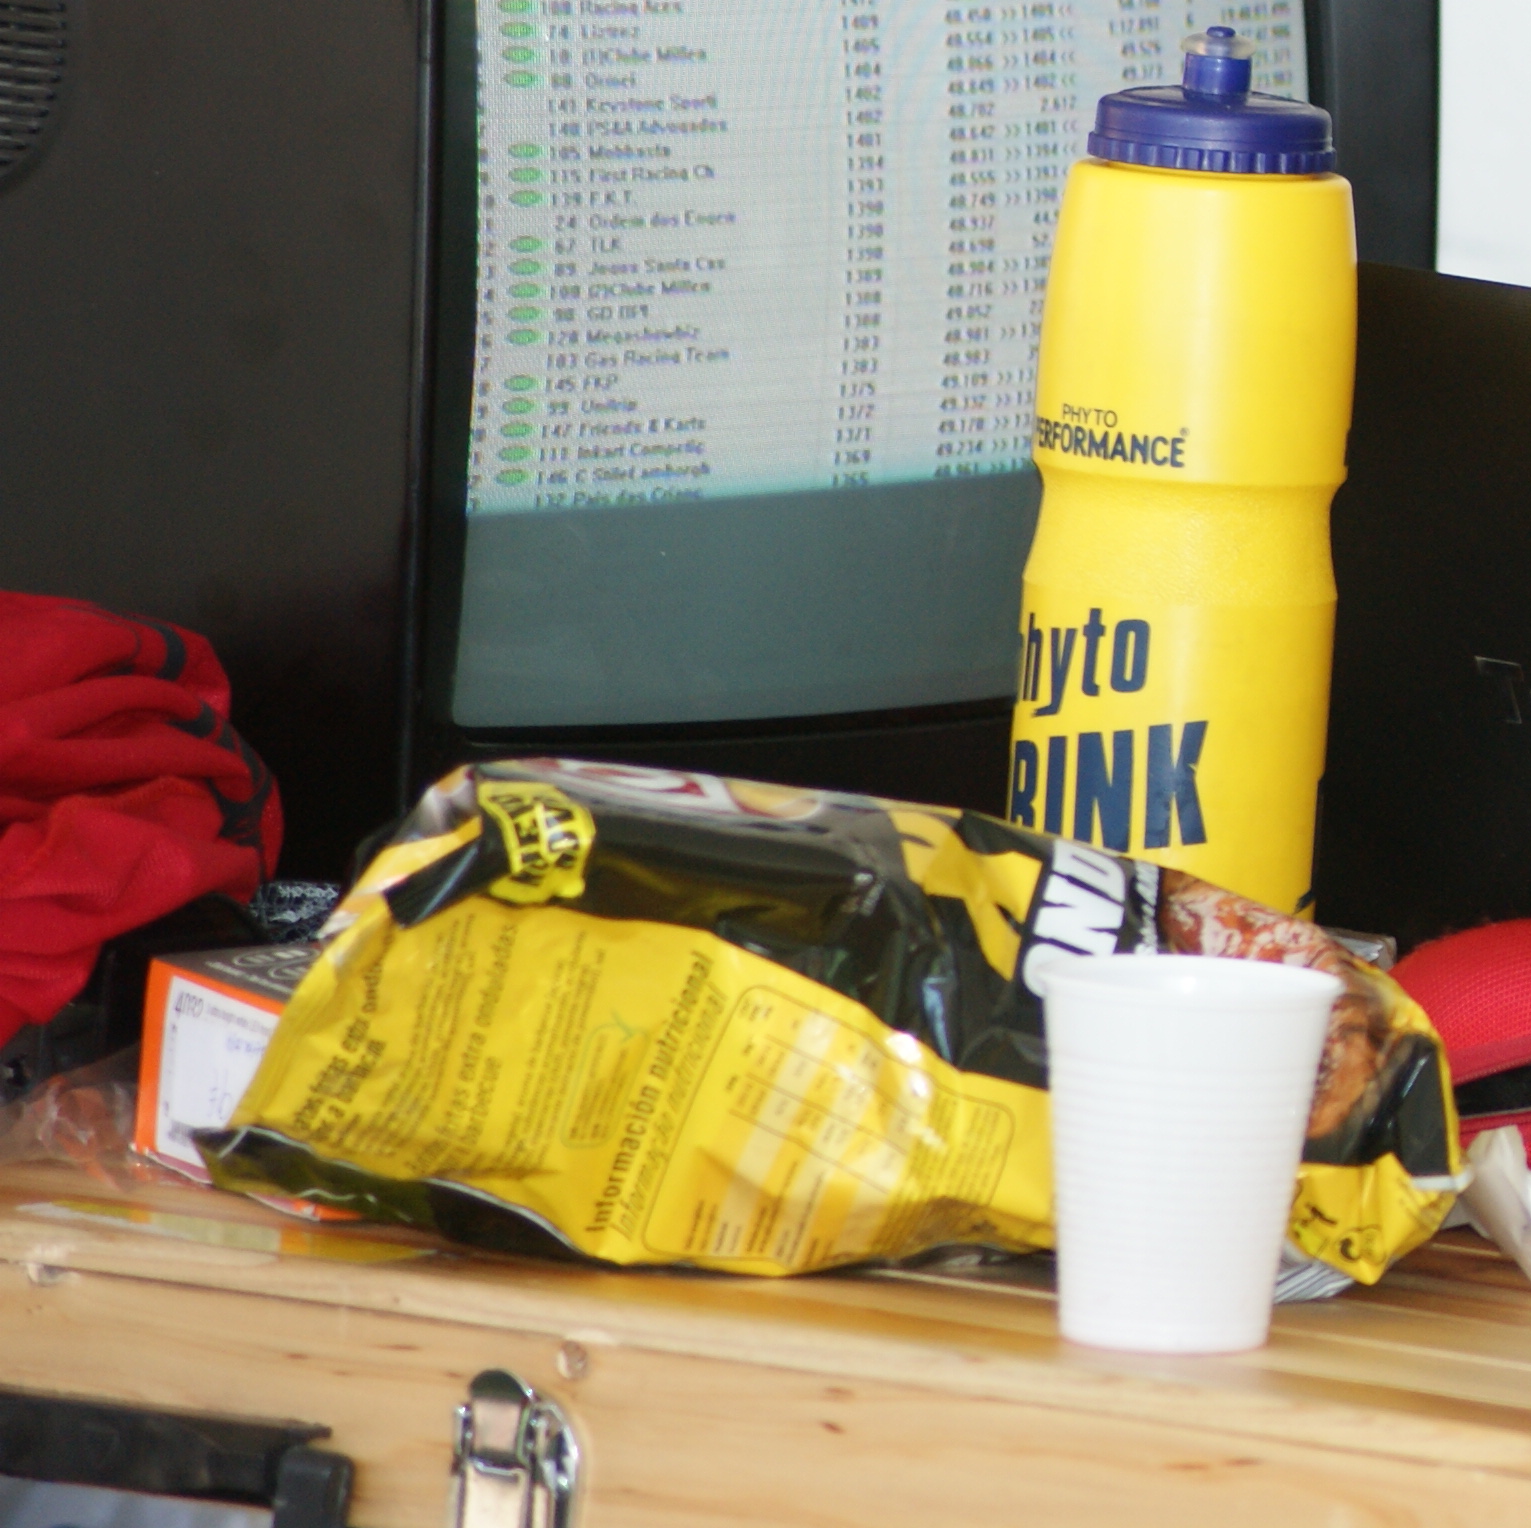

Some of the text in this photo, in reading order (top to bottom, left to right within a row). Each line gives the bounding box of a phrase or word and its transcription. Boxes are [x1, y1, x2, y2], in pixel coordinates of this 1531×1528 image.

[1061, 402, 1119, 429] PHYTO
[1018, 607, 1152, 719] hyto
[1010, 719, 1210, 855] RINK
[648, 949, 715, 1092] nutricional
